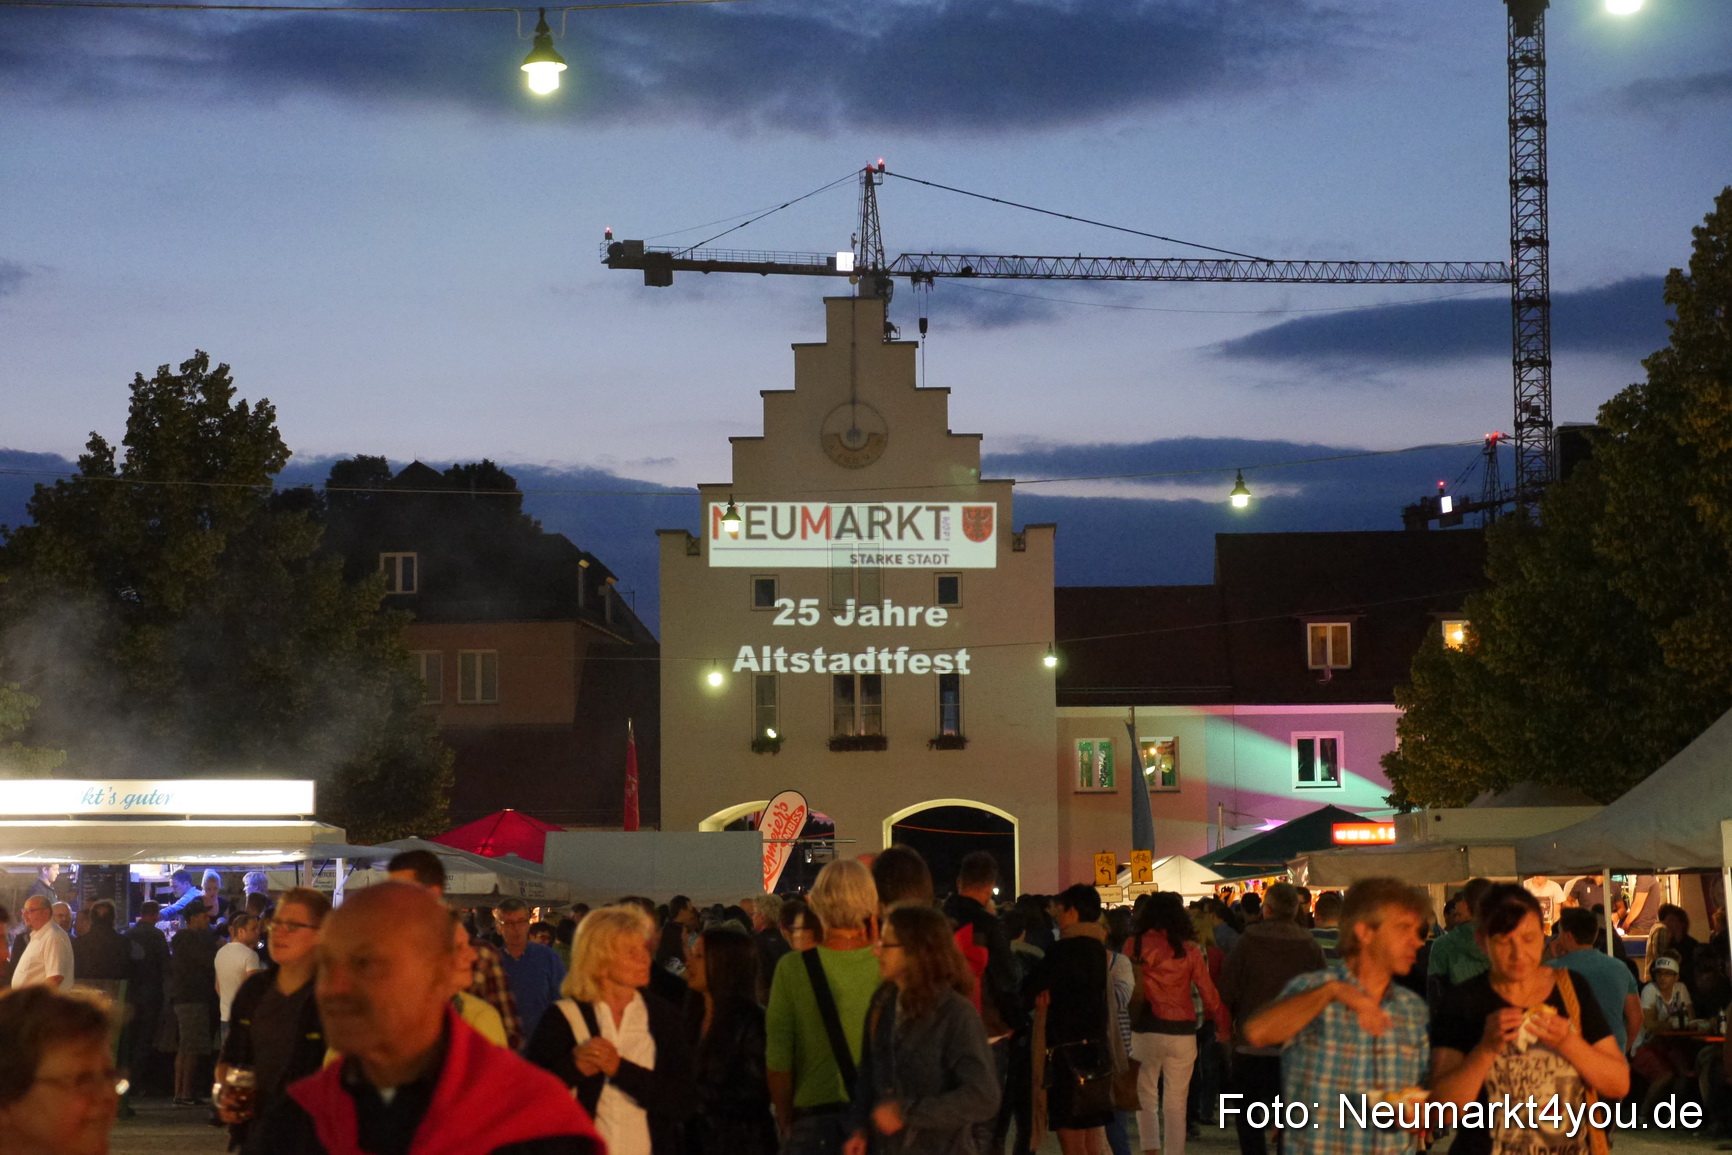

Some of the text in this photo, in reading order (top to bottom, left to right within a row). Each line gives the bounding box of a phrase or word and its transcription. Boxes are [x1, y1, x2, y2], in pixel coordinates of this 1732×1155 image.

[712, 505, 950, 541] NEUMARKT
[850, 554, 950, 566] STARKE STADT
[772, 598, 948, 628] 25 Jahre
[732, 645, 971, 676] Altstadtfest
[782, 808, 804, 843] MBISS
